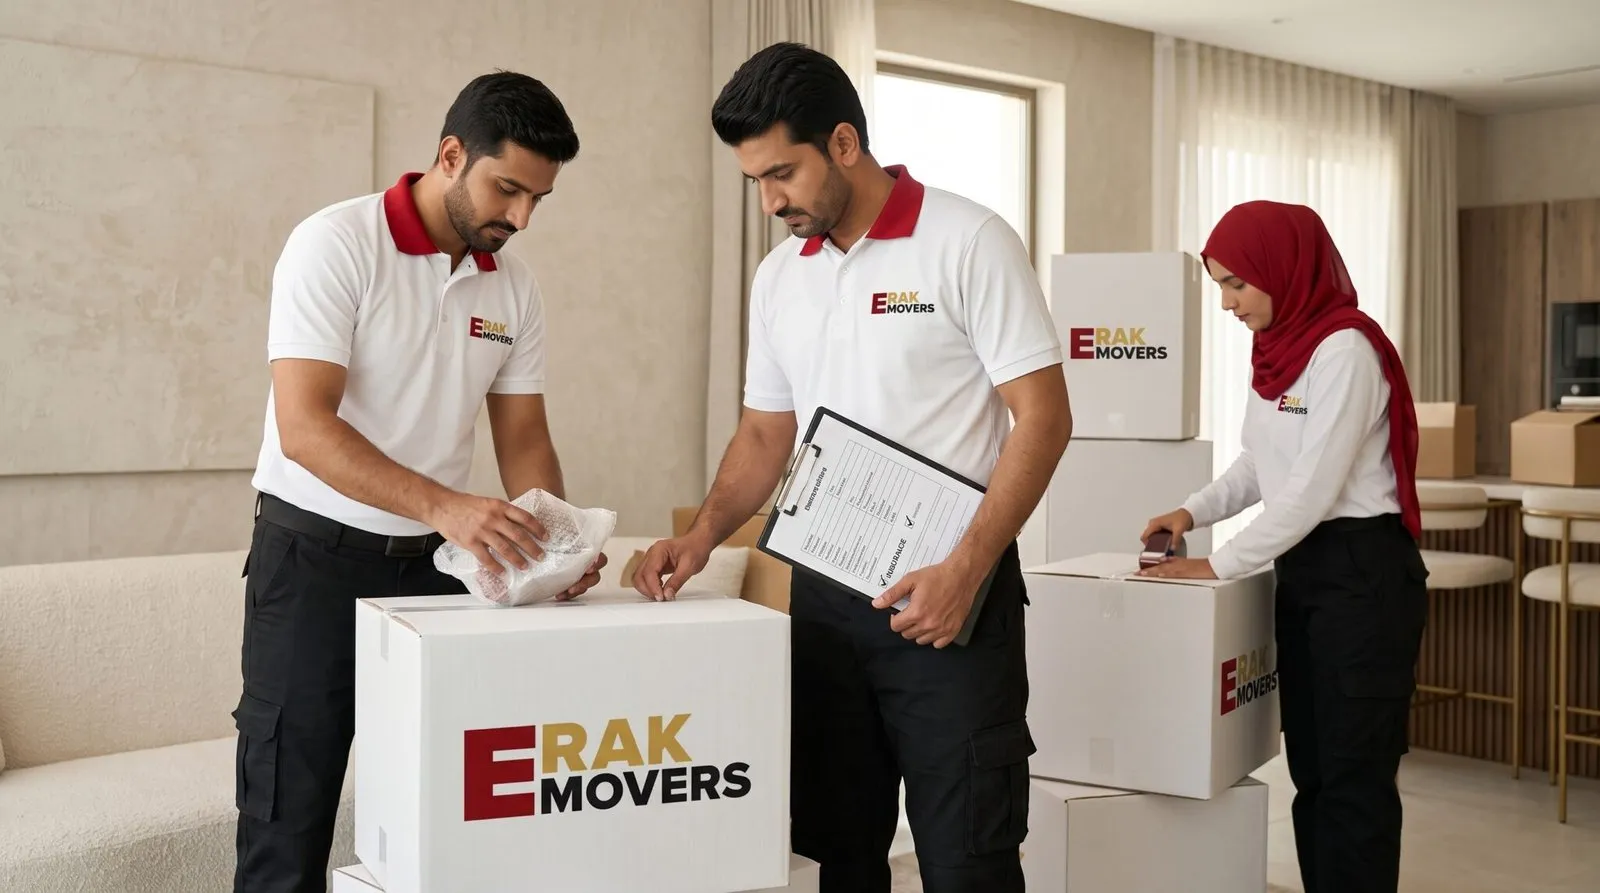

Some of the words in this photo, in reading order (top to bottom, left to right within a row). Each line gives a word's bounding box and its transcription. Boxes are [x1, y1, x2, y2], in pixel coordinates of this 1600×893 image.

[886, 303, 935, 314] MOVERS
[482, 332, 514, 346] MOVERS
[1096, 346, 1168, 360] MOVERS
[1284, 406, 1308, 415] MOVERS
[1236, 671, 1279, 707] MOVERS
[540, 761, 752, 815] MOVERS
